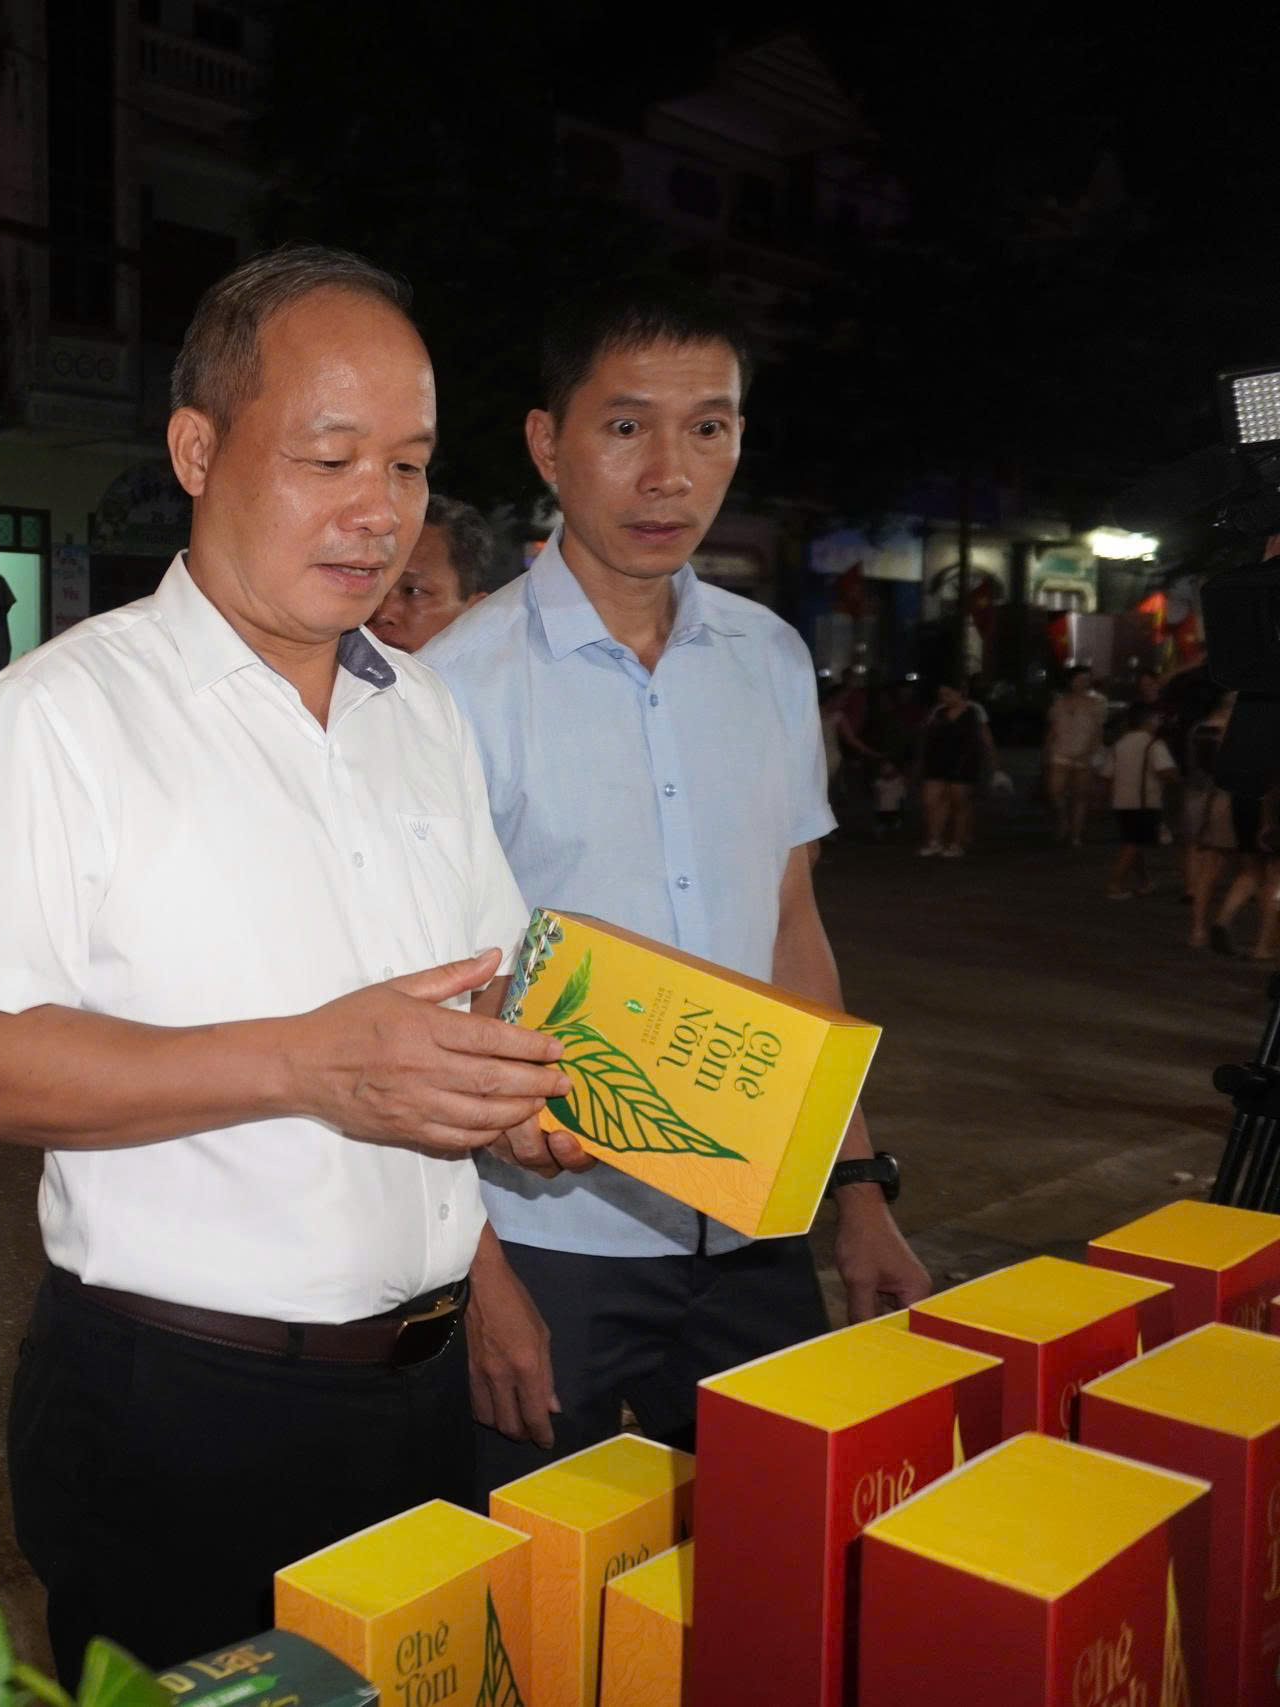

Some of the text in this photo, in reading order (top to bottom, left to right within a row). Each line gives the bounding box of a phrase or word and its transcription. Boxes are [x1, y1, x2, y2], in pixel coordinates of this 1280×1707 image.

[656, 997, 714, 1068] Nõn
[695, 1022, 751, 1092] Tôm
[734, 1030, 782, 1099] Chè
[396, 1620, 449, 1676] Chè
